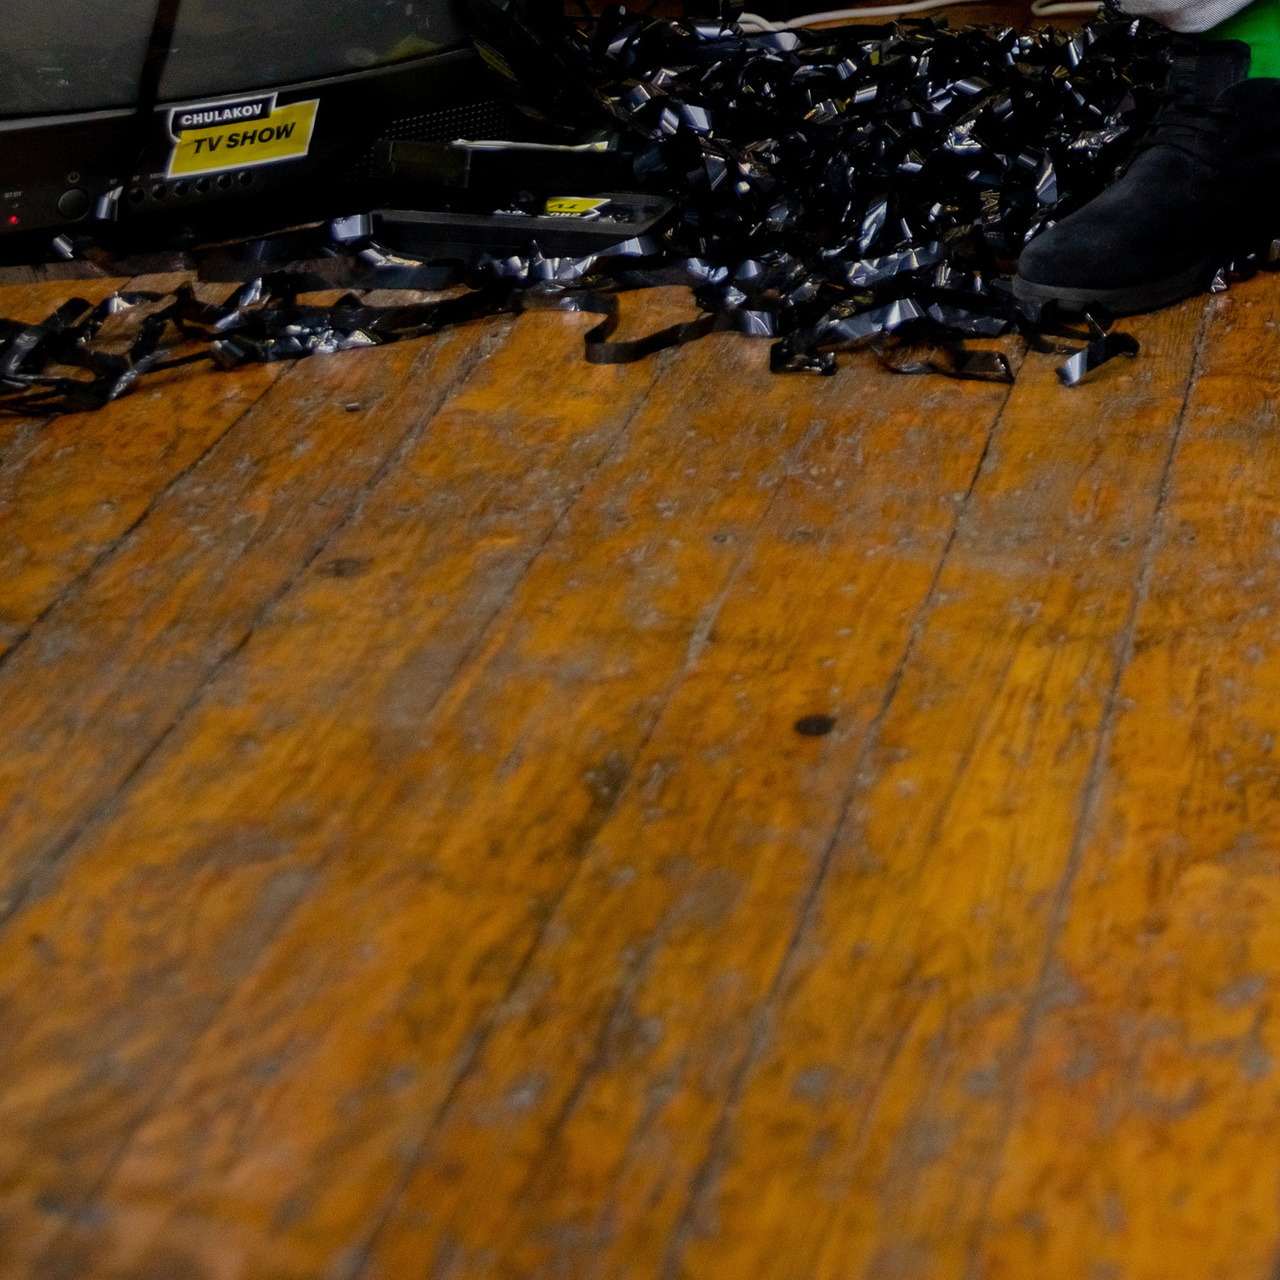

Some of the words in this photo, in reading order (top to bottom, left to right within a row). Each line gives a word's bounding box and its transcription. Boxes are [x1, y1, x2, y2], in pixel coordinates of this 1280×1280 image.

[181, 103, 263, 125] CHULAKOV
[194, 135, 223, 155] TV
[226, 122, 296, 149] SHOW
